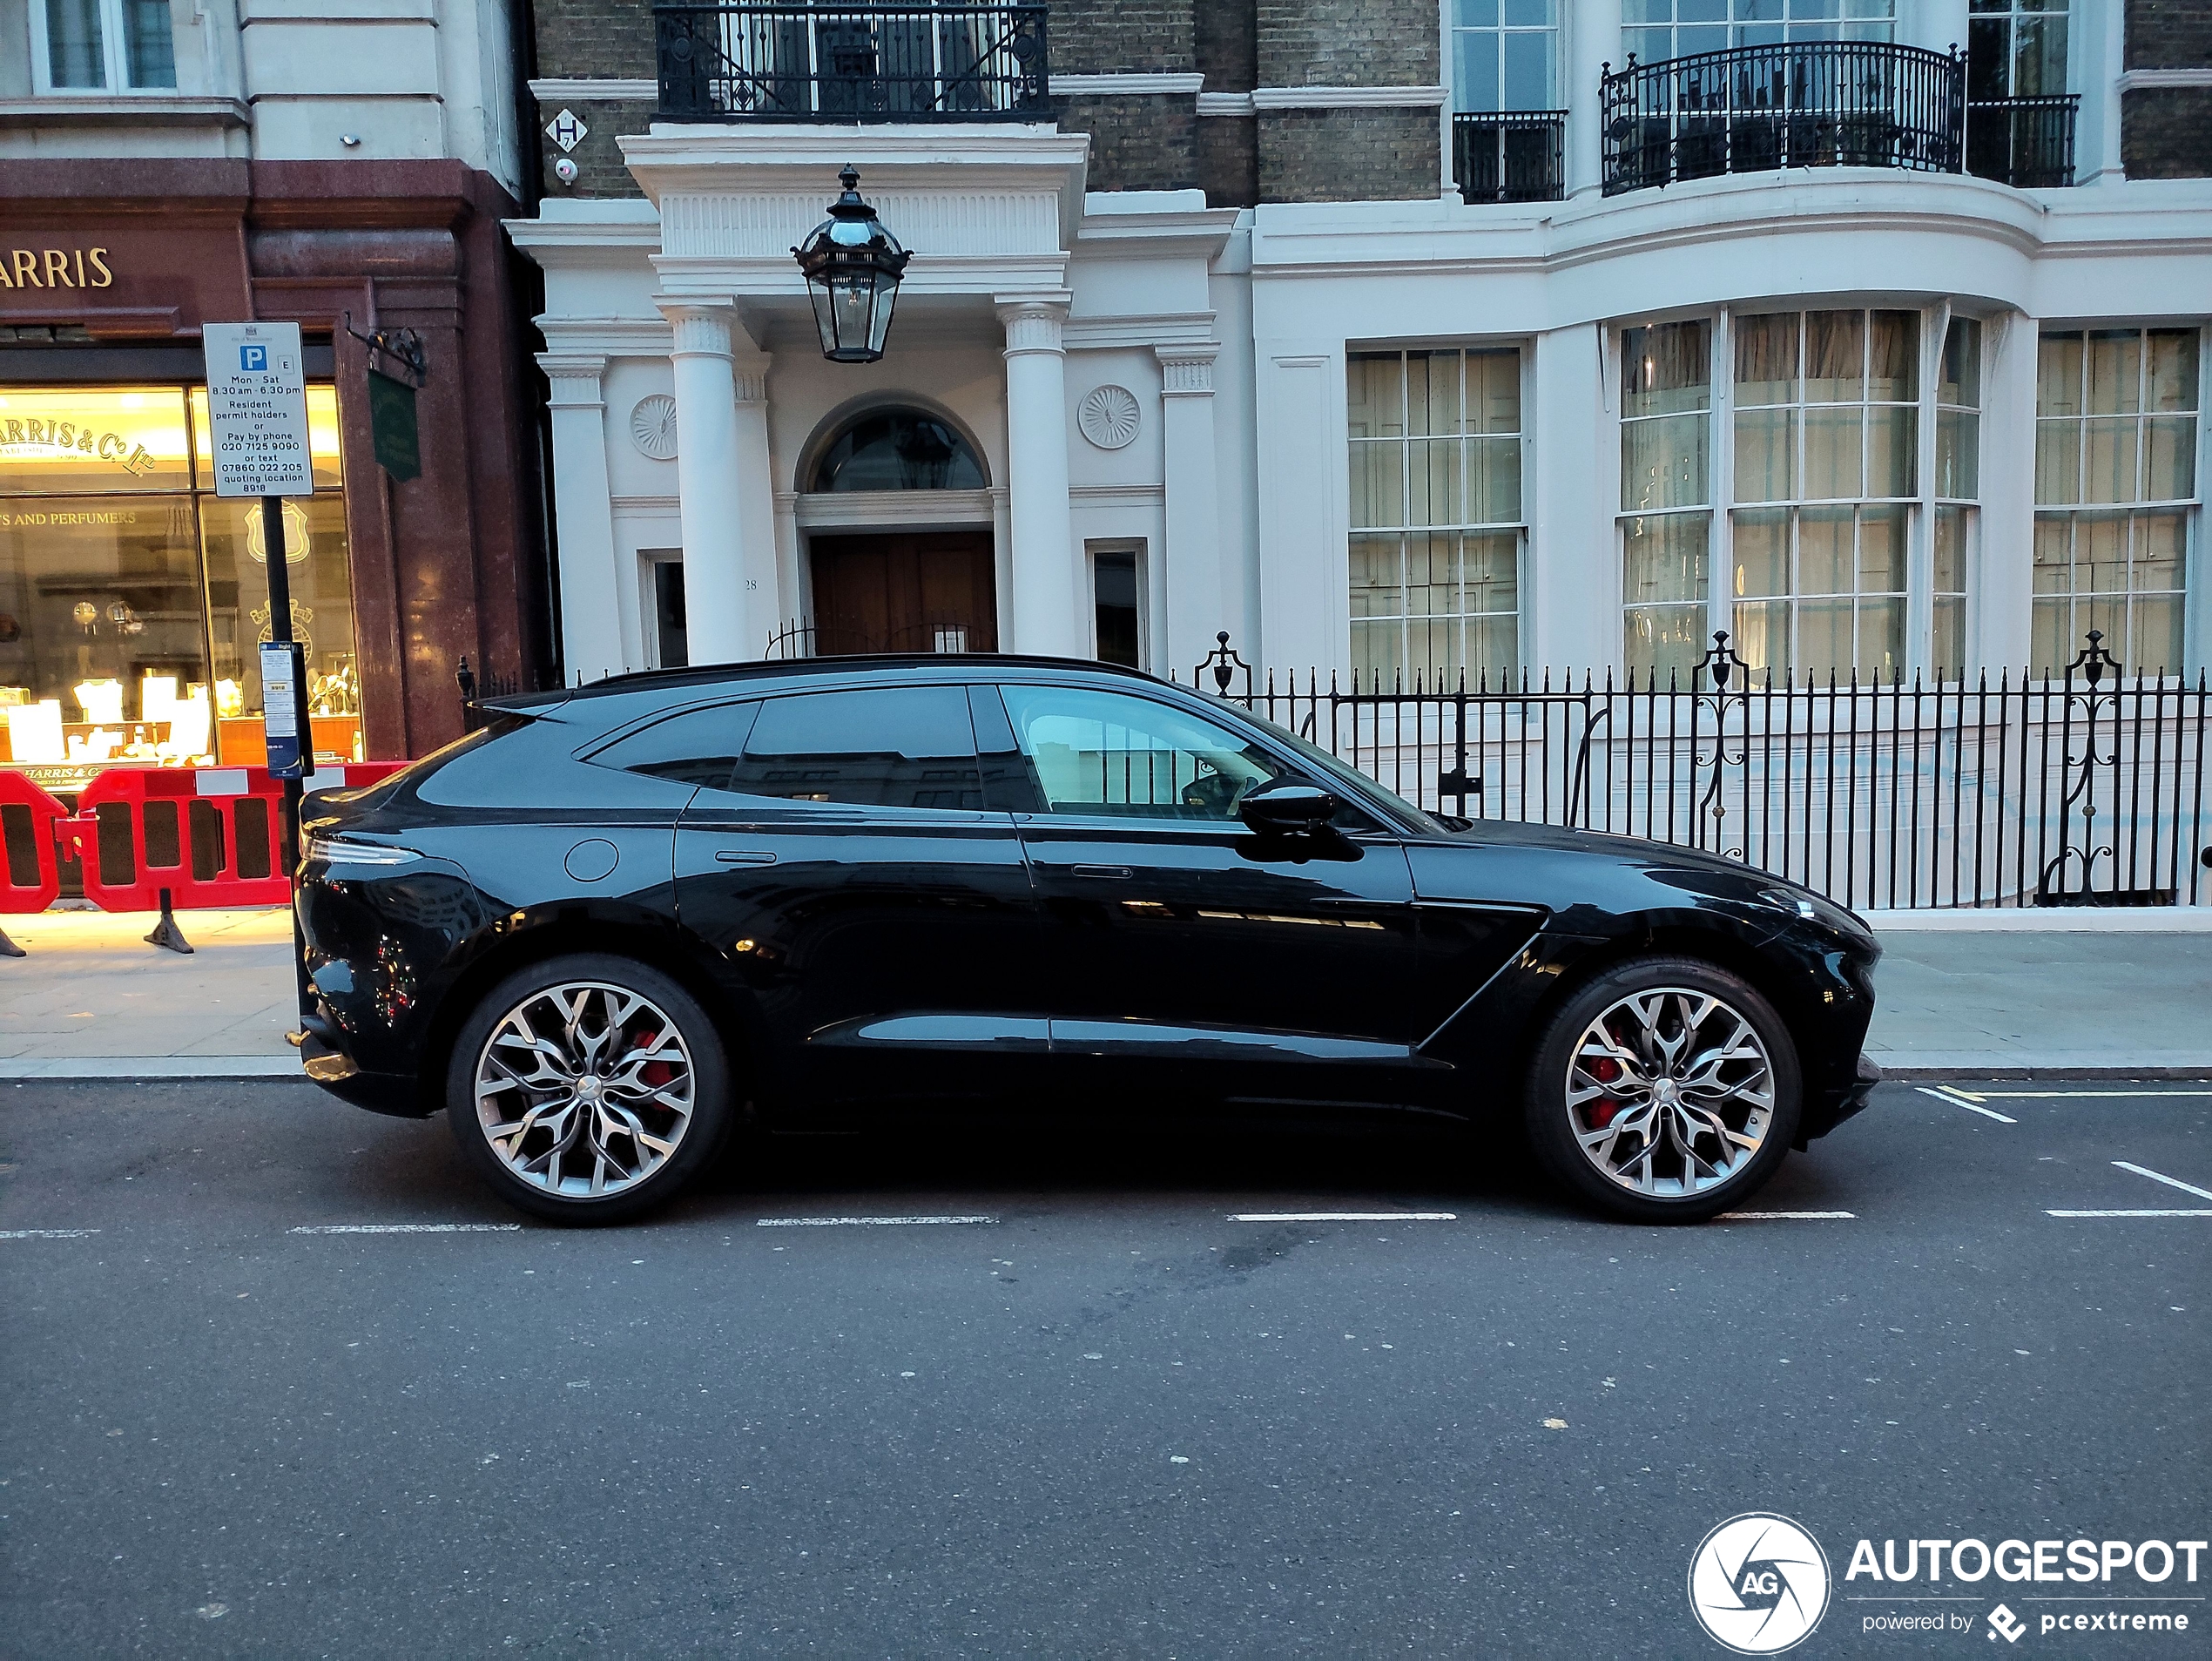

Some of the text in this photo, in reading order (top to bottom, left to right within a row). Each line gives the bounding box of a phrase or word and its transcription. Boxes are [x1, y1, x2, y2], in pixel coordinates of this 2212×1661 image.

[556, 119, 577, 142] H
[563, 137, 570, 147] 7
[246, 348, 263, 369] P
[216, 410, 287, 420] permit holders
[228, 432, 293, 442] Pay by phone
[221, 442, 242, 451] 020
[272, 442, 300, 450] 9090
[225, 475, 261, 483] quoting
[14, 513, 46, 525] AND
[51, 512, 136, 524] PERFUMERS
